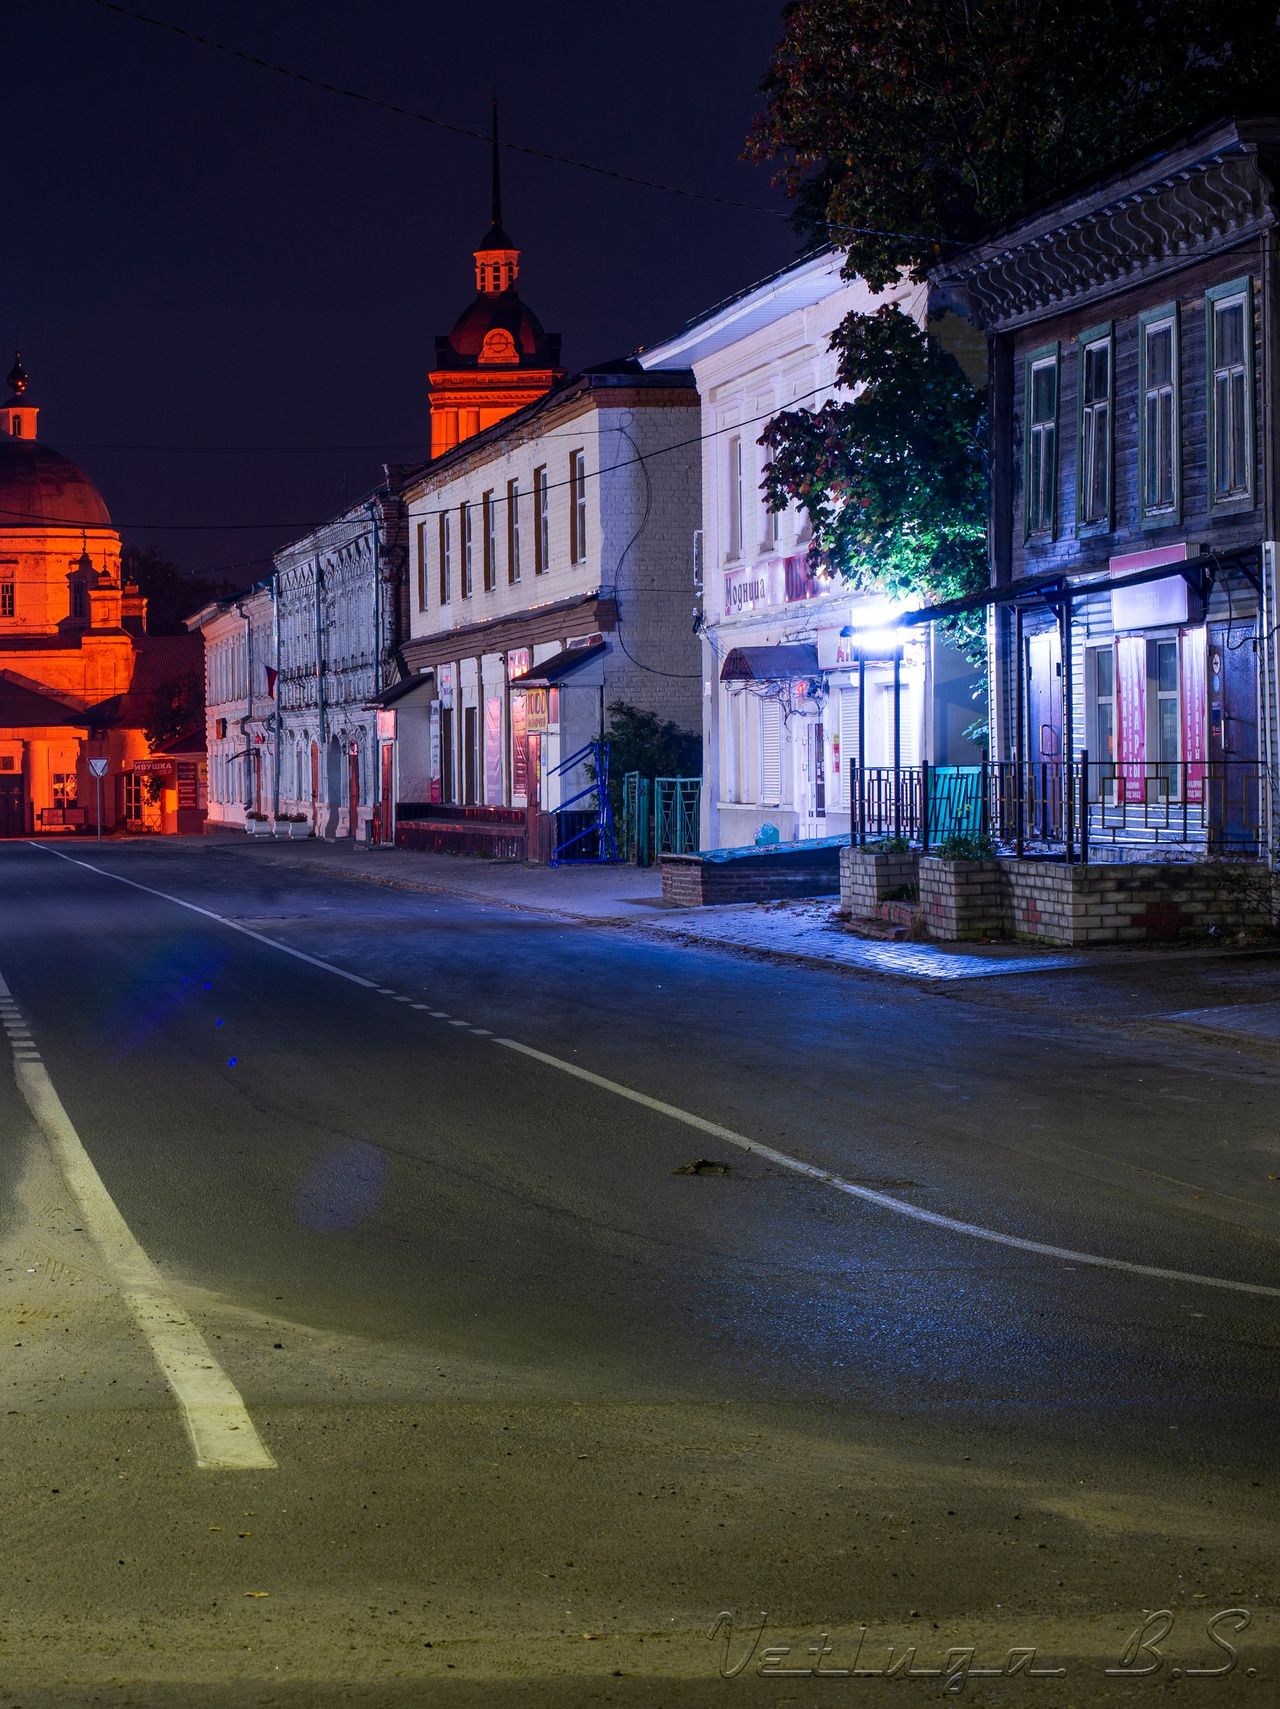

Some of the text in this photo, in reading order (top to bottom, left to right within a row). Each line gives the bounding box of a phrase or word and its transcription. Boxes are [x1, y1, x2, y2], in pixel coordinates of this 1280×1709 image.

[725, 577, 765, 611] Модница
[527, 692, 546, 714] 1000
[134, 763, 172, 771] ИВУШКА
